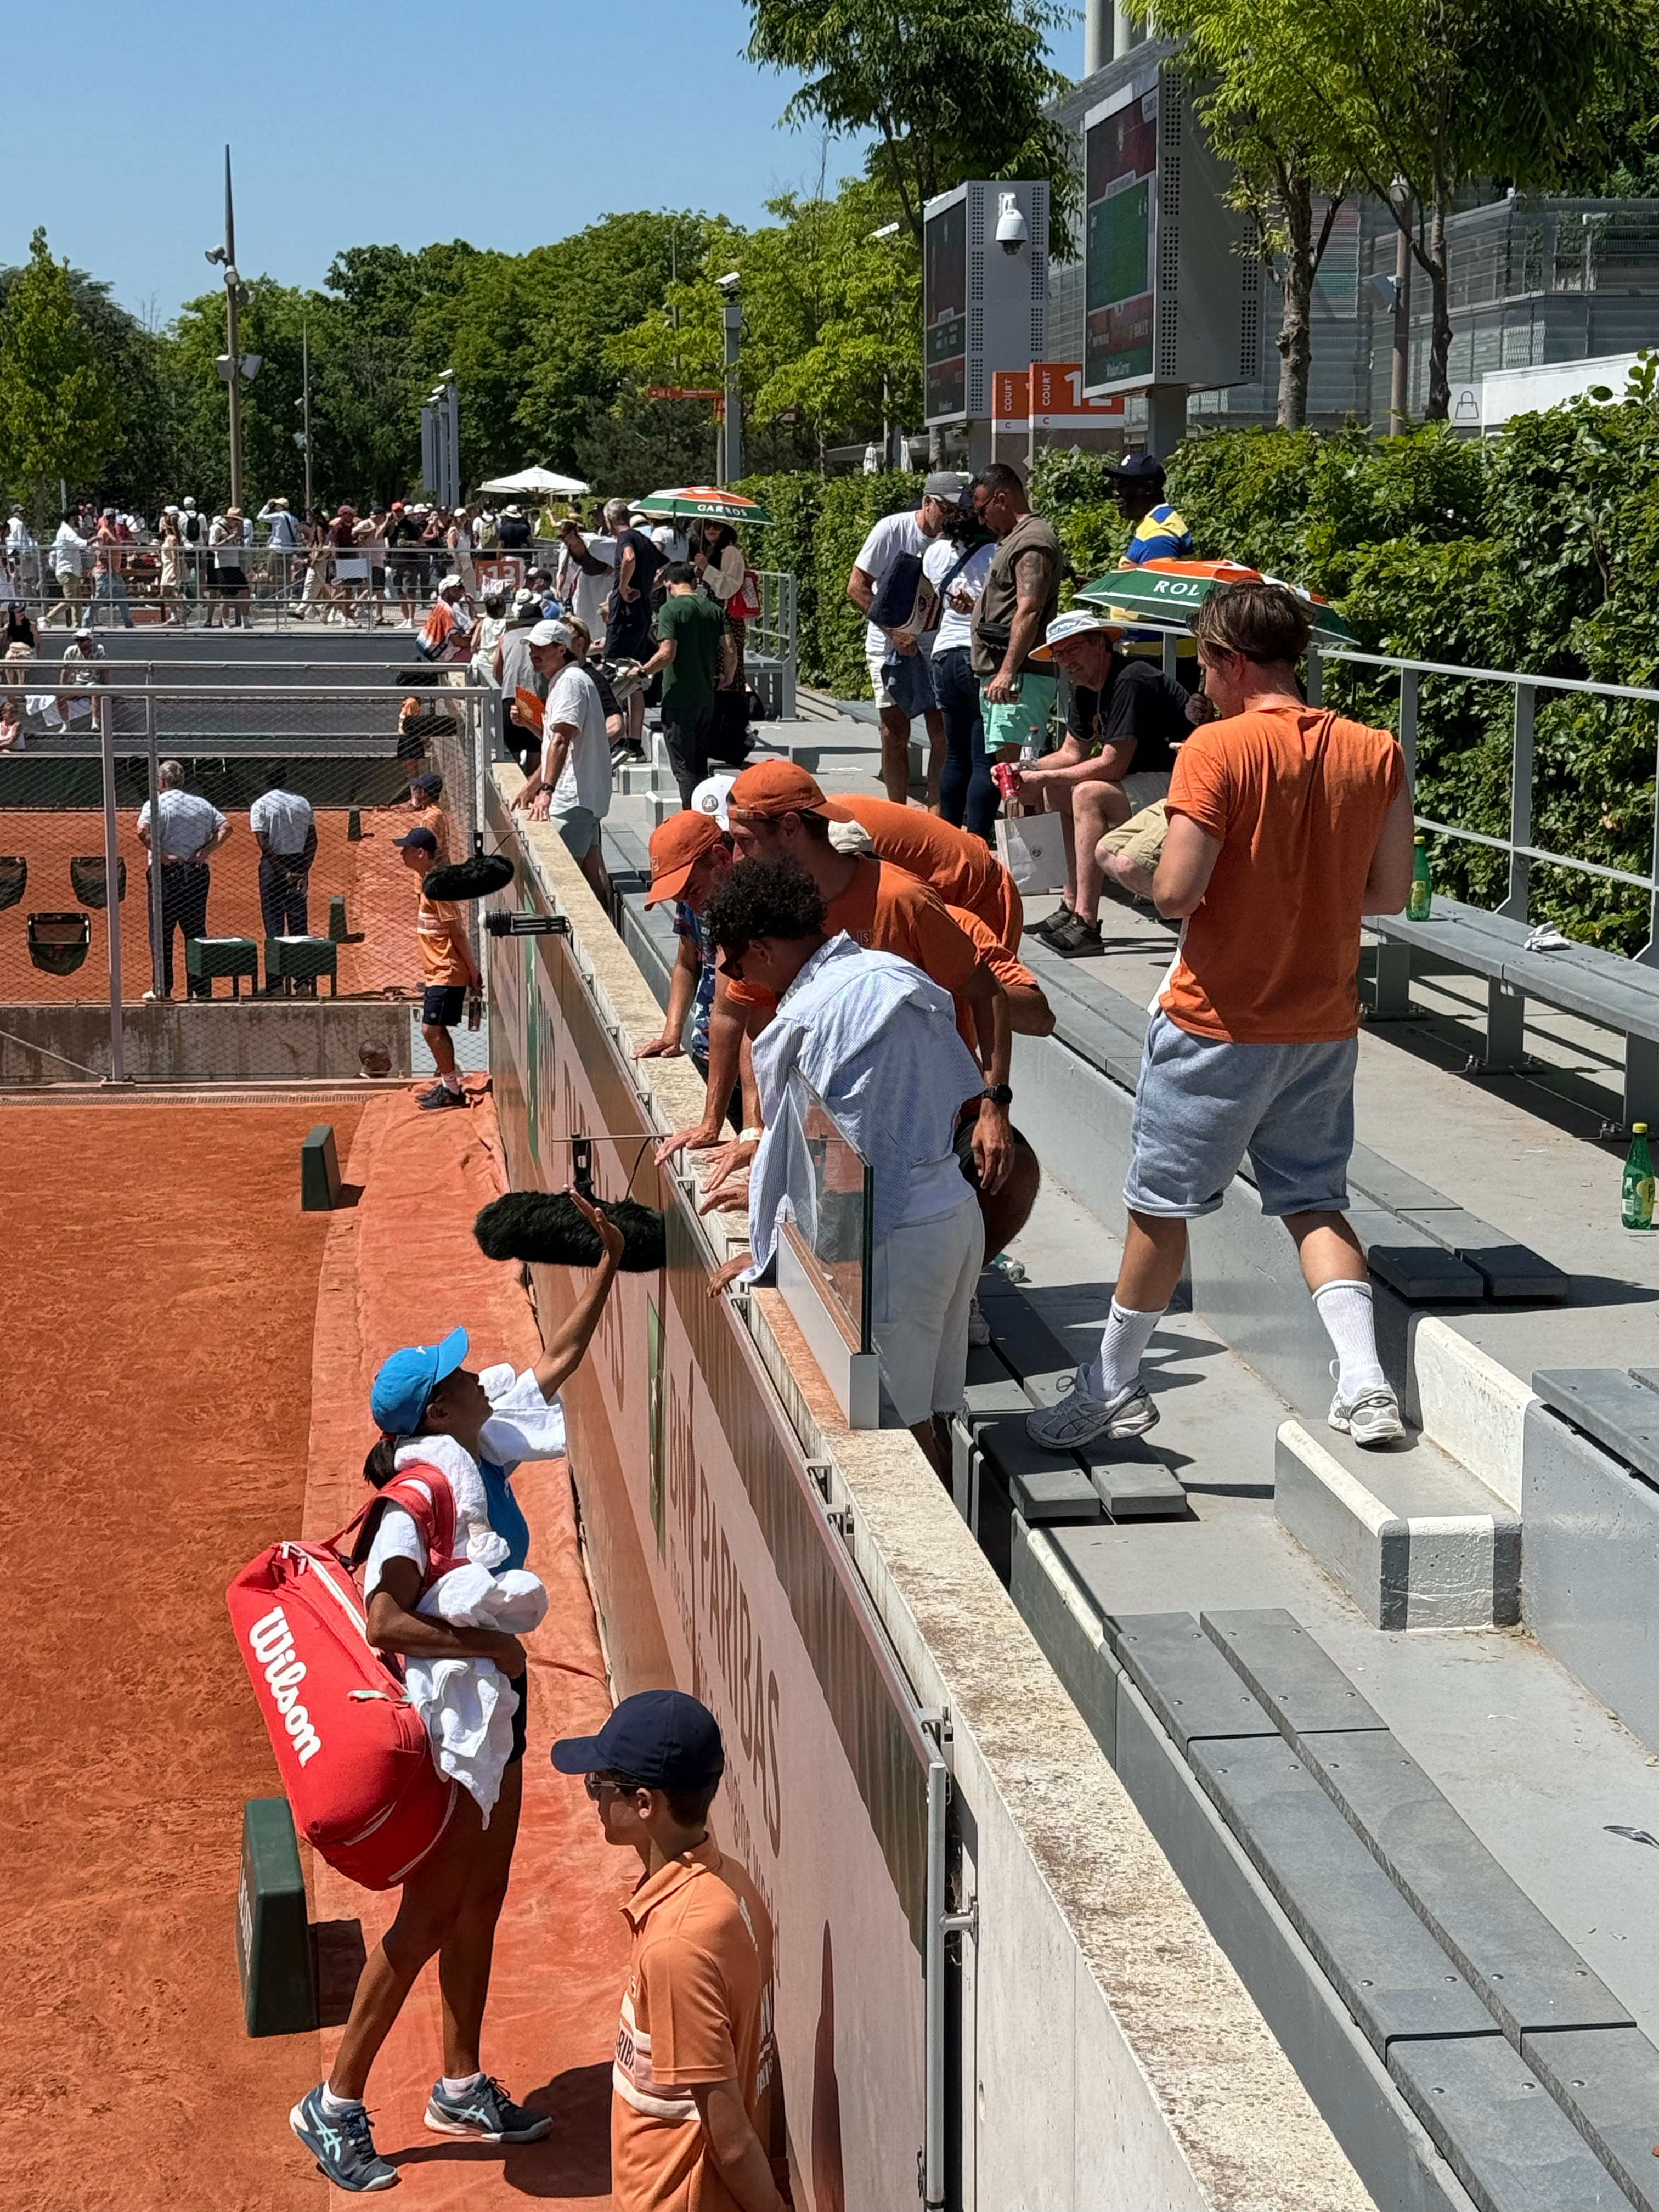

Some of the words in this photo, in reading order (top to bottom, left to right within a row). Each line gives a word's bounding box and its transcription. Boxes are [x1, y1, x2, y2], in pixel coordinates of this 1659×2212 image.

[1004, 379, 1012, 412] COURT
[1042, 371, 1051, 406] COURT
[1064, 371, 1113, 406] 1
[670, 1372, 695, 1565] BNP
[700, 1463, 781, 1859] PARIBAS
[249, 1605, 321, 1768] Wilson
